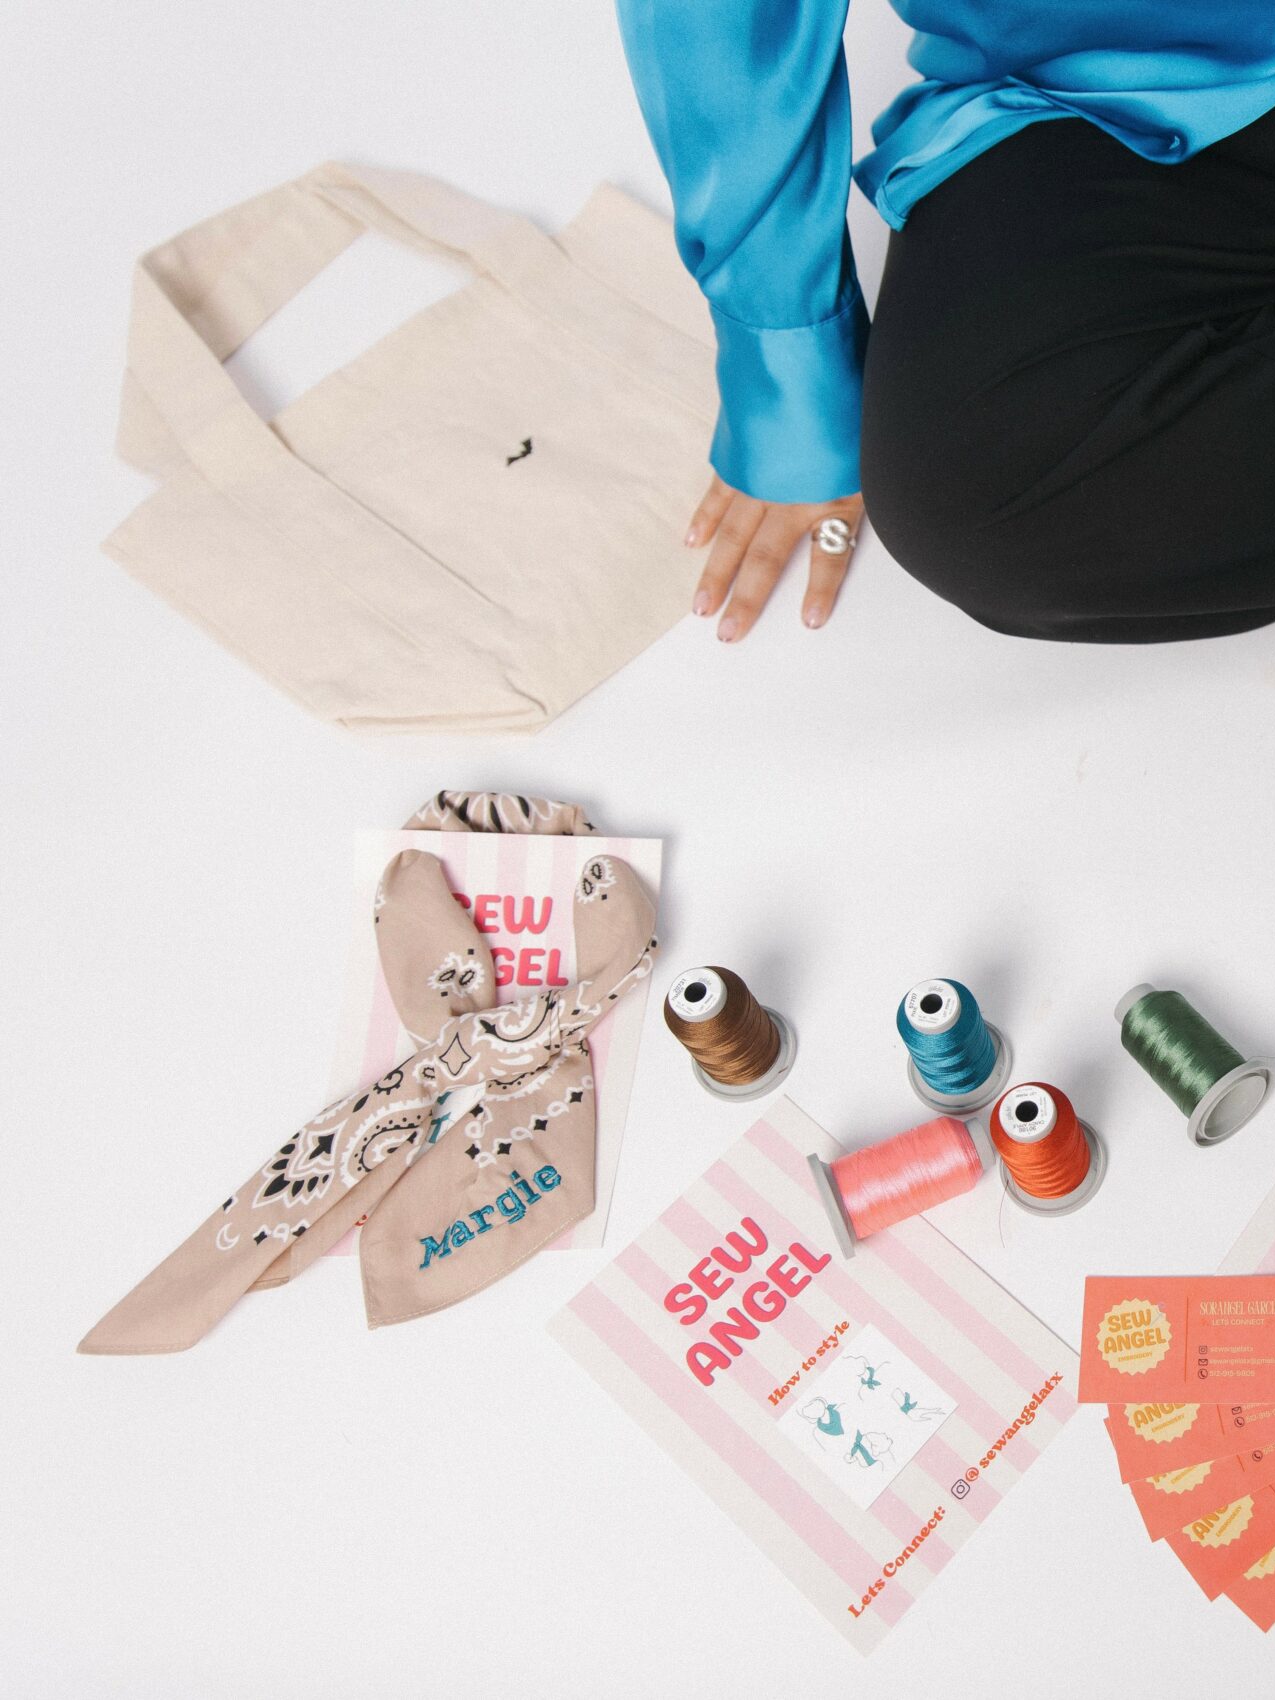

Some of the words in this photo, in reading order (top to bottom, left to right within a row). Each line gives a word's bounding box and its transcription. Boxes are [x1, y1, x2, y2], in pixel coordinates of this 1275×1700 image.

[451, 893, 553, 935] EW
[490, 947, 569, 987] GEL
[418, 1164, 562, 1271] Margie
[663, 1216, 770, 1327] SEW
[686, 1242, 832, 1387] ANGEL
[1107, 1309, 1152, 1333] SEW
[1199, 1301, 1245, 1315] SORANGEL
[1212, 1318, 1229, 1326] LETS
[1230, 1318, 1265, 1326] CONNECT
[1103, 1327, 1167, 1354] ANGEL
[1118, 1351, 1153, 1362] EMBROIDERY
[766, 1369, 804, 1409] How
[800, 1353, 818, 1371] to
[814, 1320, 852, 1359] style
[963, 1466, 982, 1485] @
[979, 1370, 1065, 1470] sewangelatx
[847, 1578, 886, 1620] Lets
[881, 1504, 947, 1580] Connect:
